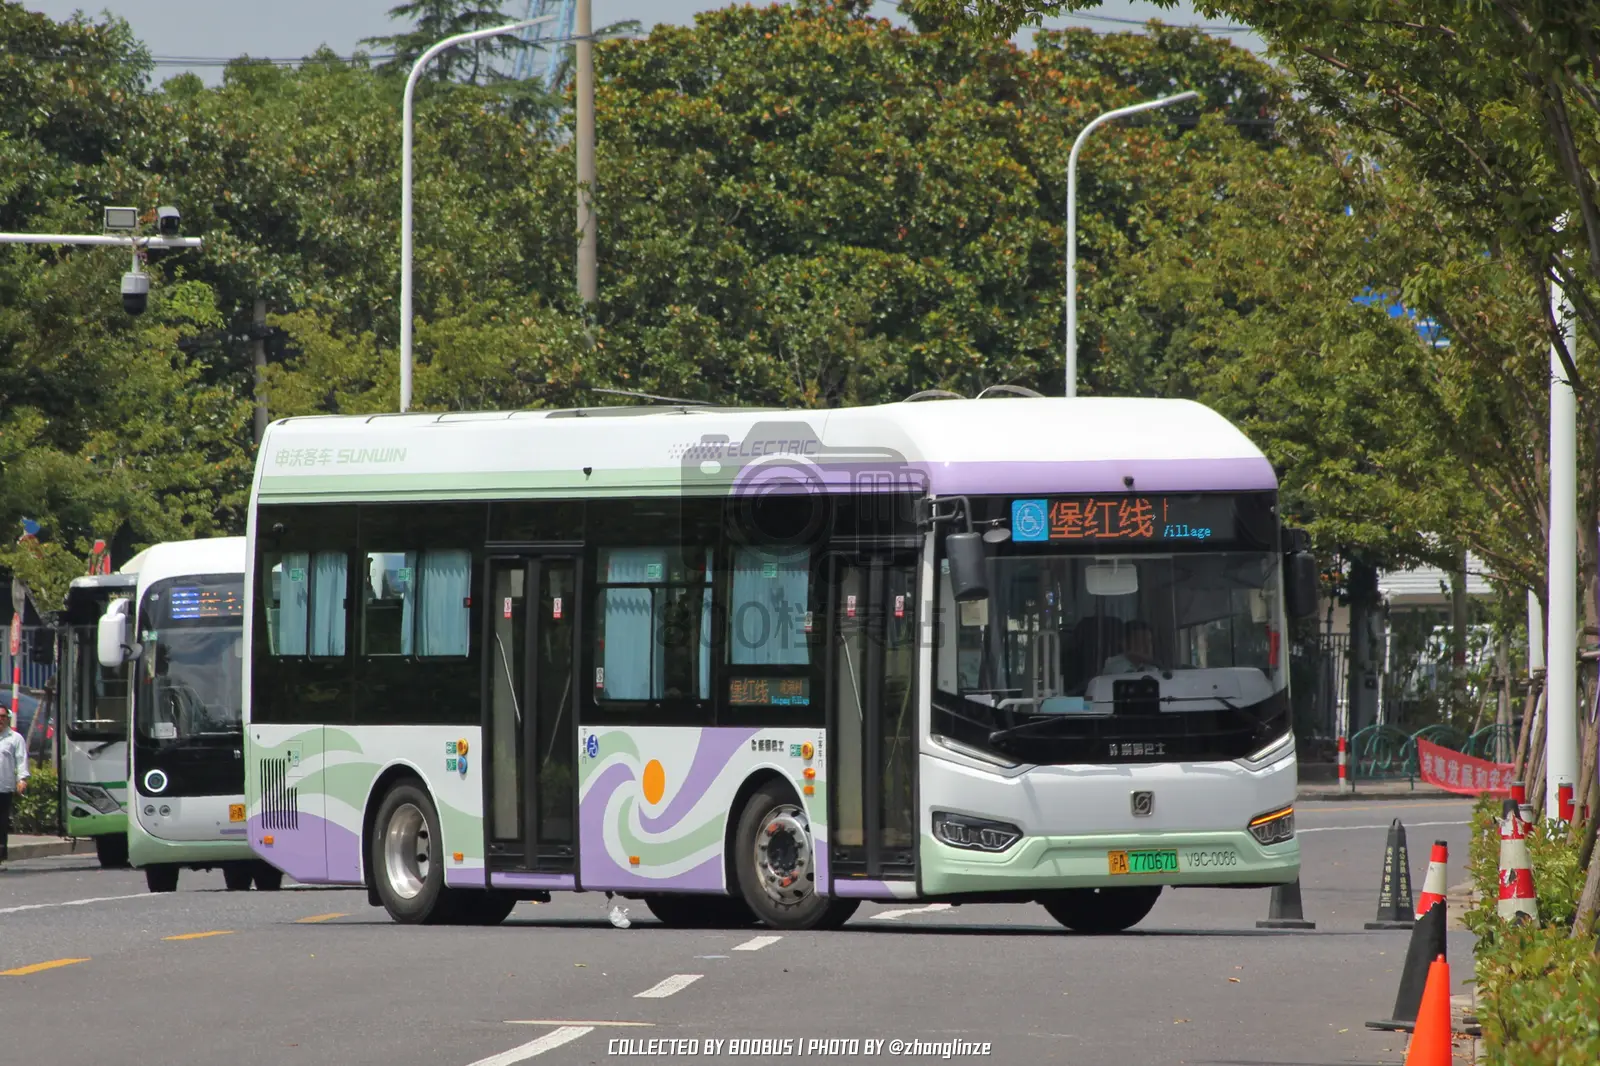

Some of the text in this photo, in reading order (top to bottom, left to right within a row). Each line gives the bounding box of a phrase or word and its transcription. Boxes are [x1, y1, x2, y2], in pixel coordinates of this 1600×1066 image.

[275, 448, 407, 467] 申沃客车 SUNWIN
[727, 440, 817, 457] ELECTRIC
[1049, 498, 1154, 539] 堡红线
[1185, 851, 1237, 867] V9C-0066
